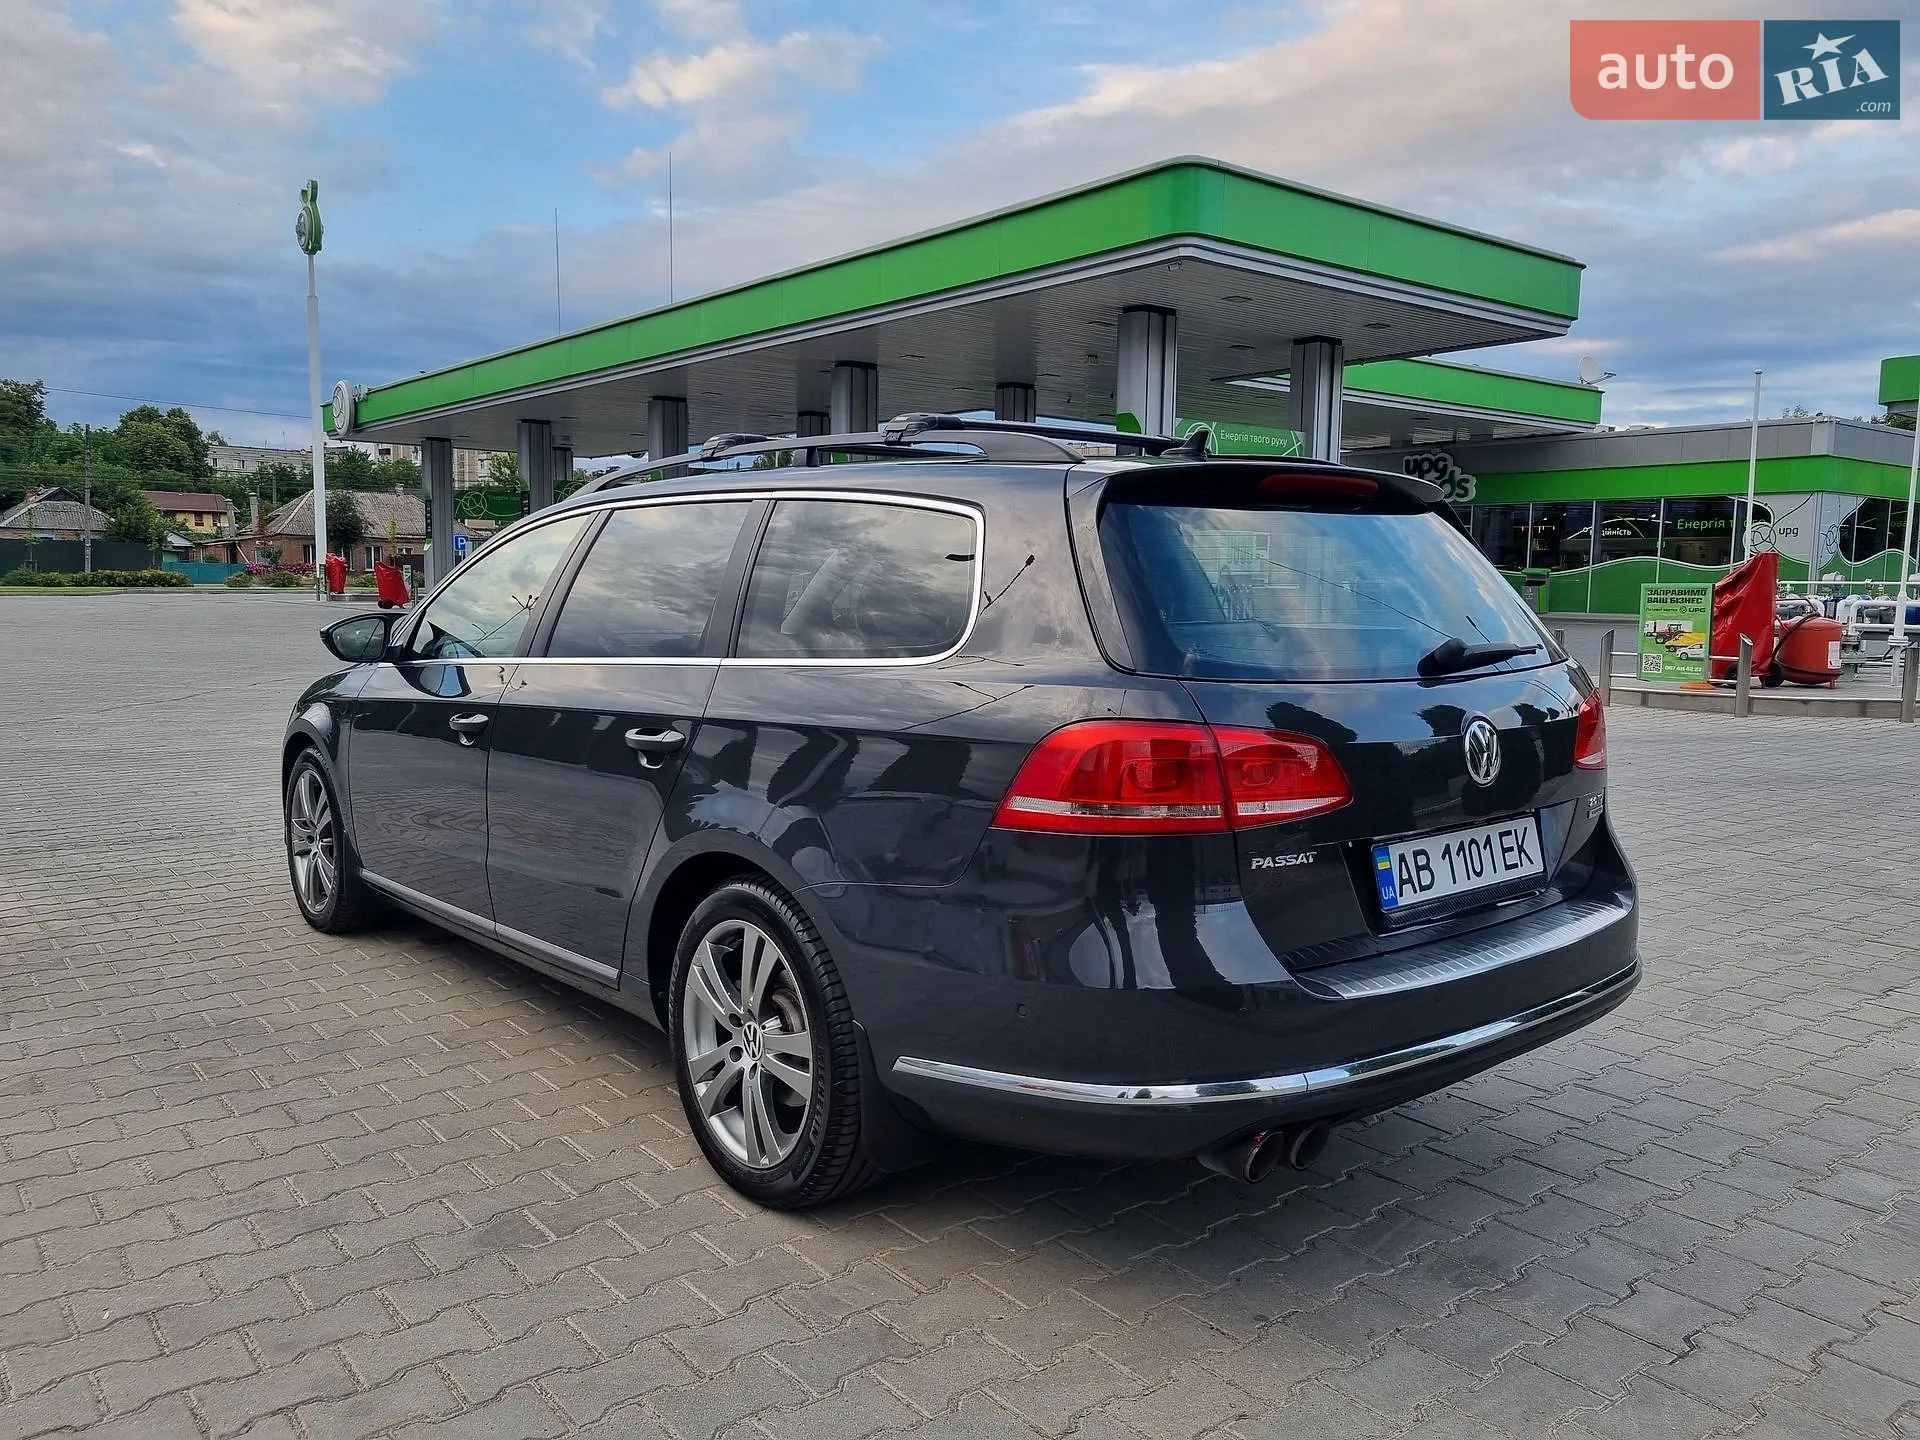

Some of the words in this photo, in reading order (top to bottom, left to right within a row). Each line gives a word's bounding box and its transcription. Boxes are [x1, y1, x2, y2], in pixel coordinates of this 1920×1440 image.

[1220, 429, 1249, 442] Енергія
[1250, 434, 1270, 443] твого
[1271, 437, 1288, 448] руху
[1404, 456, 1449, 480] upg
[1676, 518, 1725, 531] Енергія
[1778, 527, 1799, 537] upg
[1251, 851, 1318, 870] PASSAT
[1398, 847, 1436, 898] AB
[1440, 833, 1498, 885] 1101
[1498, 826, 1534, 872] EK
[1381, 886, 1396, 901] UA
